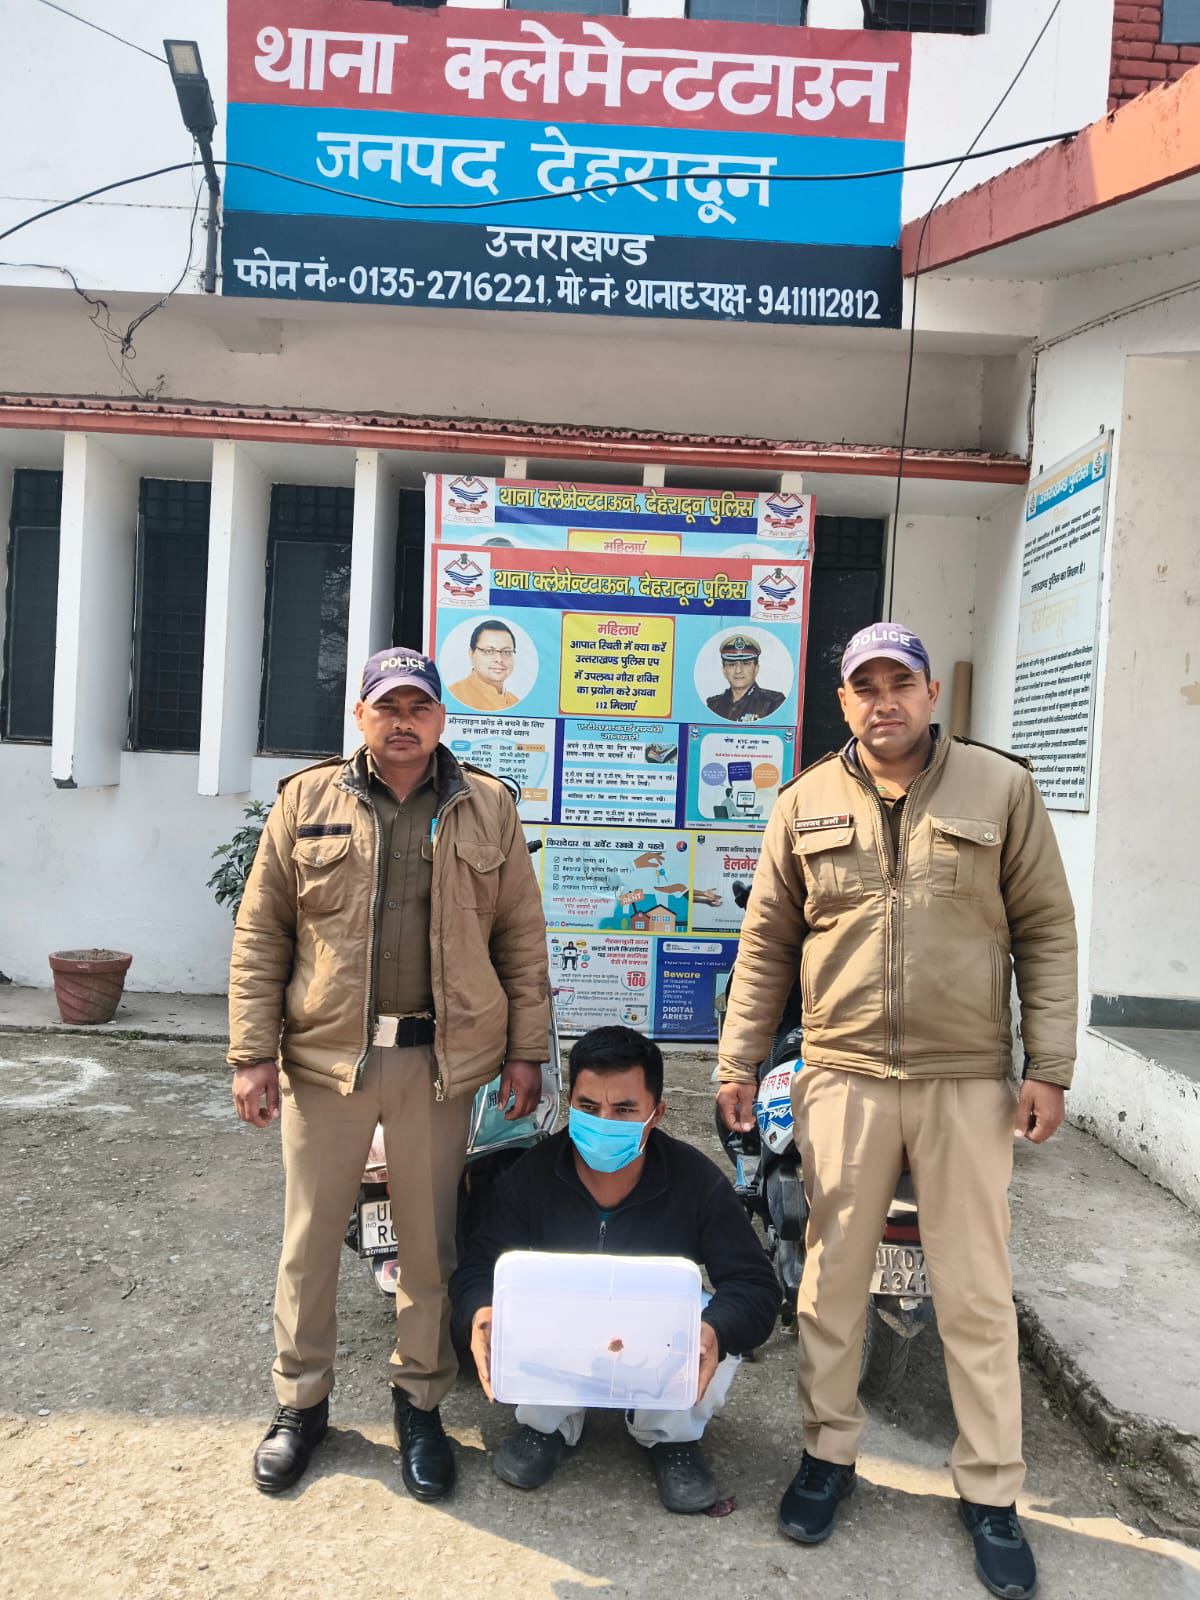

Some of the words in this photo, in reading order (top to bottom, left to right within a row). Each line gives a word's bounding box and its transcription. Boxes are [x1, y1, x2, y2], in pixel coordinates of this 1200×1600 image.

[254, 26, 408, 95] थाना
[445, 20, 900, 124] क्लेमेन्टटाउन
[316, 131, 504, 196] जनपद
[530, 126, 778, 225] देहरादून
[486, 225, 655, 266] उत्तराखण्ड
[233, 247, 301, 291] फोन
[758, 284, 882, 320] 9411112812
[499, 487, 536, 508] थाना
[645, 486, 707, 524] देहरादून
[709, 490, 754, 525] पुलिस
[494, 570, 530, 590] थाना
[639, 570, 699, 607] देहरादून
[702, 571, 748, 608] पुलिस
[597, 620, 642, 636] महिलाएं
[570, 640, 596, 649] आपात
[624, 640, 633, 650] में
[634, 643, 650, 652] क्या
[852, 629, 911, 652] POLICE
[380, 656, 426, 672] POLICE
[621, 653, 646, 668] पुलिस
[647, 658, 660, 666] एप
[574, 669, 583, 680] में
[576, 686, 589, 694] का
[590, 684, 614, 696] प्रयोग
[632, 688, 656, 697] अथवा
[596, 701, 607, 709] 112
[610, 698, 639, 711] मिलाएं
[522, 719, 530, 727] के
[530, 720, 545, 728] लिए
[626, 976, 646, 987] 100
[663, 970, 701, 979] Beware
[662, 1006, 694, 1014] DIGITAL
[377, 1202, 393, 1221] U
